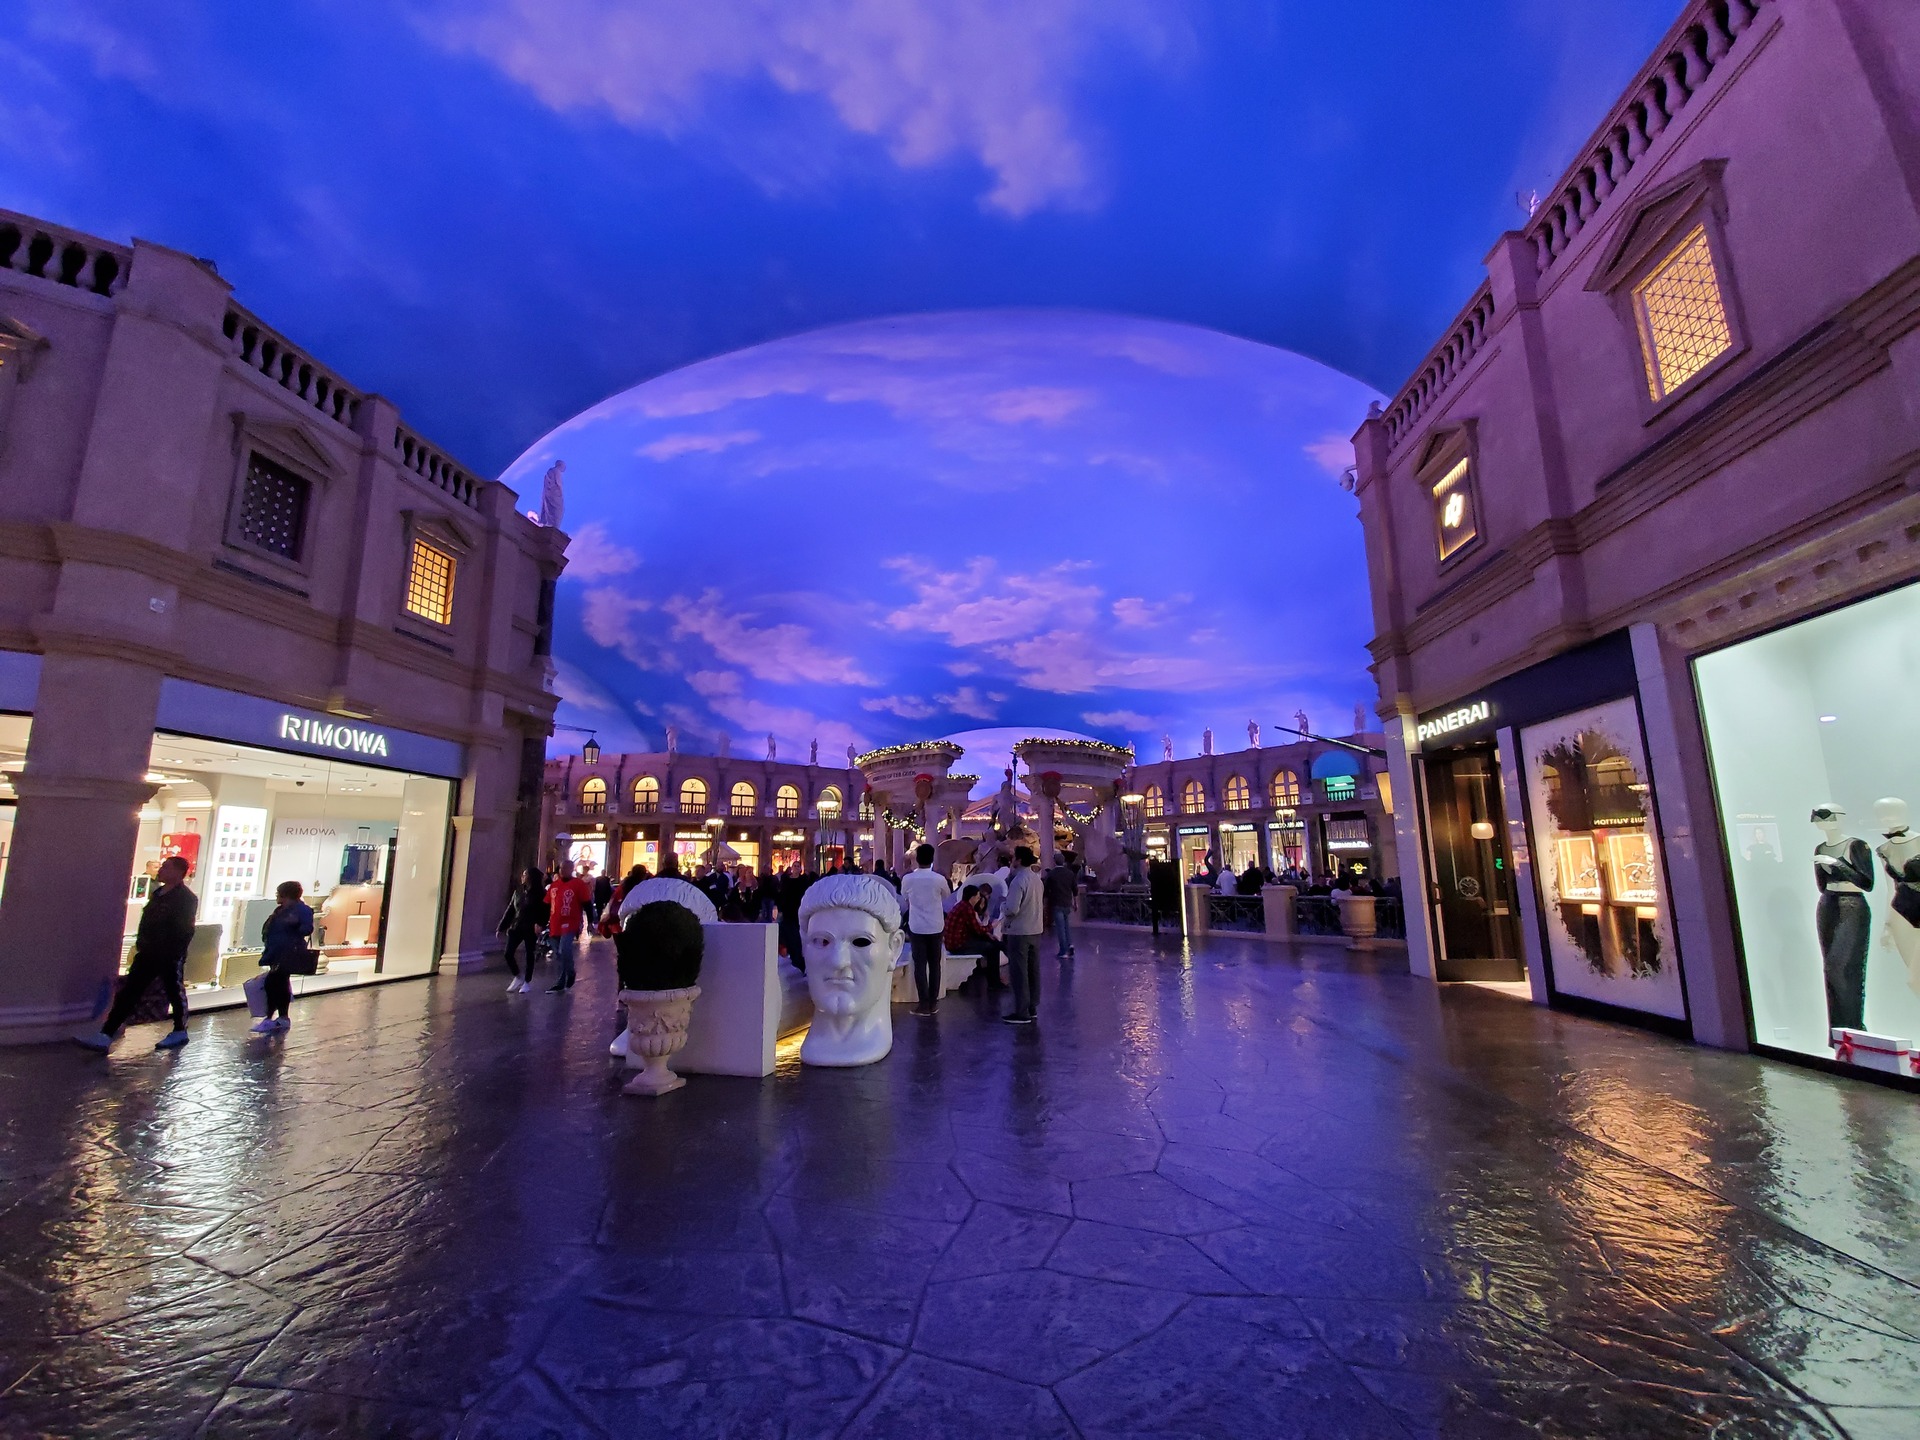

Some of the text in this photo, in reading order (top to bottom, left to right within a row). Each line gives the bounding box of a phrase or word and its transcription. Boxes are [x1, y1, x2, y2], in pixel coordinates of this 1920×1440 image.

[281, 715, 388, 757] RIMOWA
[1417, 700, 1489, 742] PANERAI
[285, 827, 336, 836] RIMOWA
